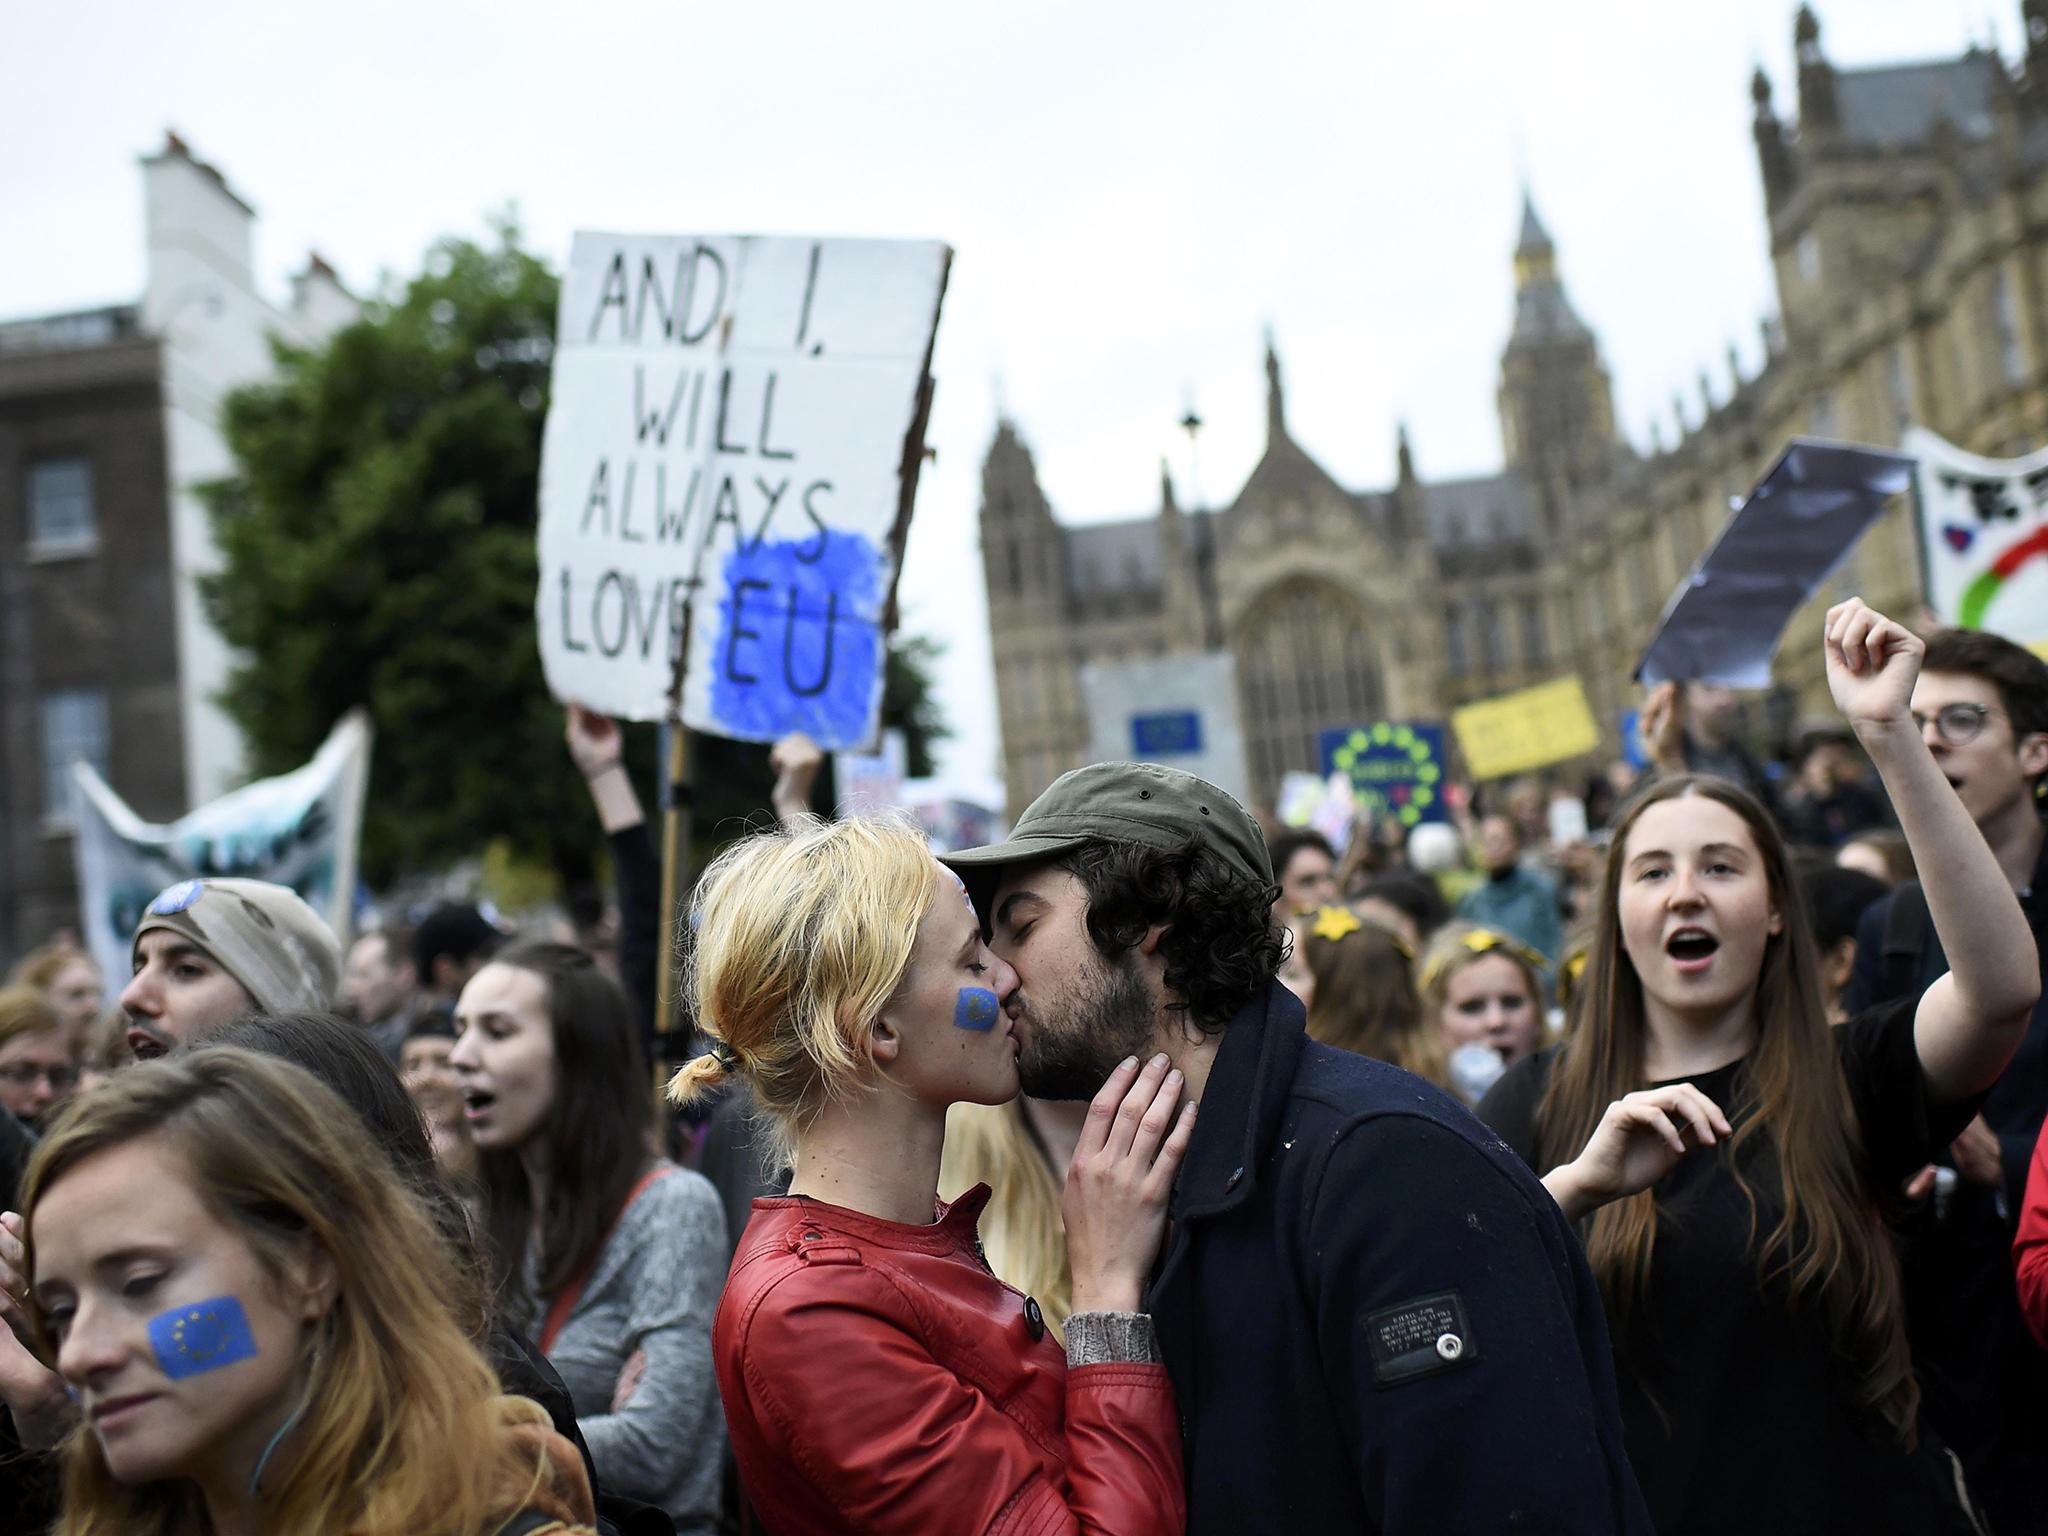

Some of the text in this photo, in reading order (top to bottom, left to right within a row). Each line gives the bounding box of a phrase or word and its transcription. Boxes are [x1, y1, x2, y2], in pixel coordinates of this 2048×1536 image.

[633, 364, 796, 461] WILL
[579, 457, 834, 564] ALWAYS
[561, 567, 837, 698] LOVE EU
